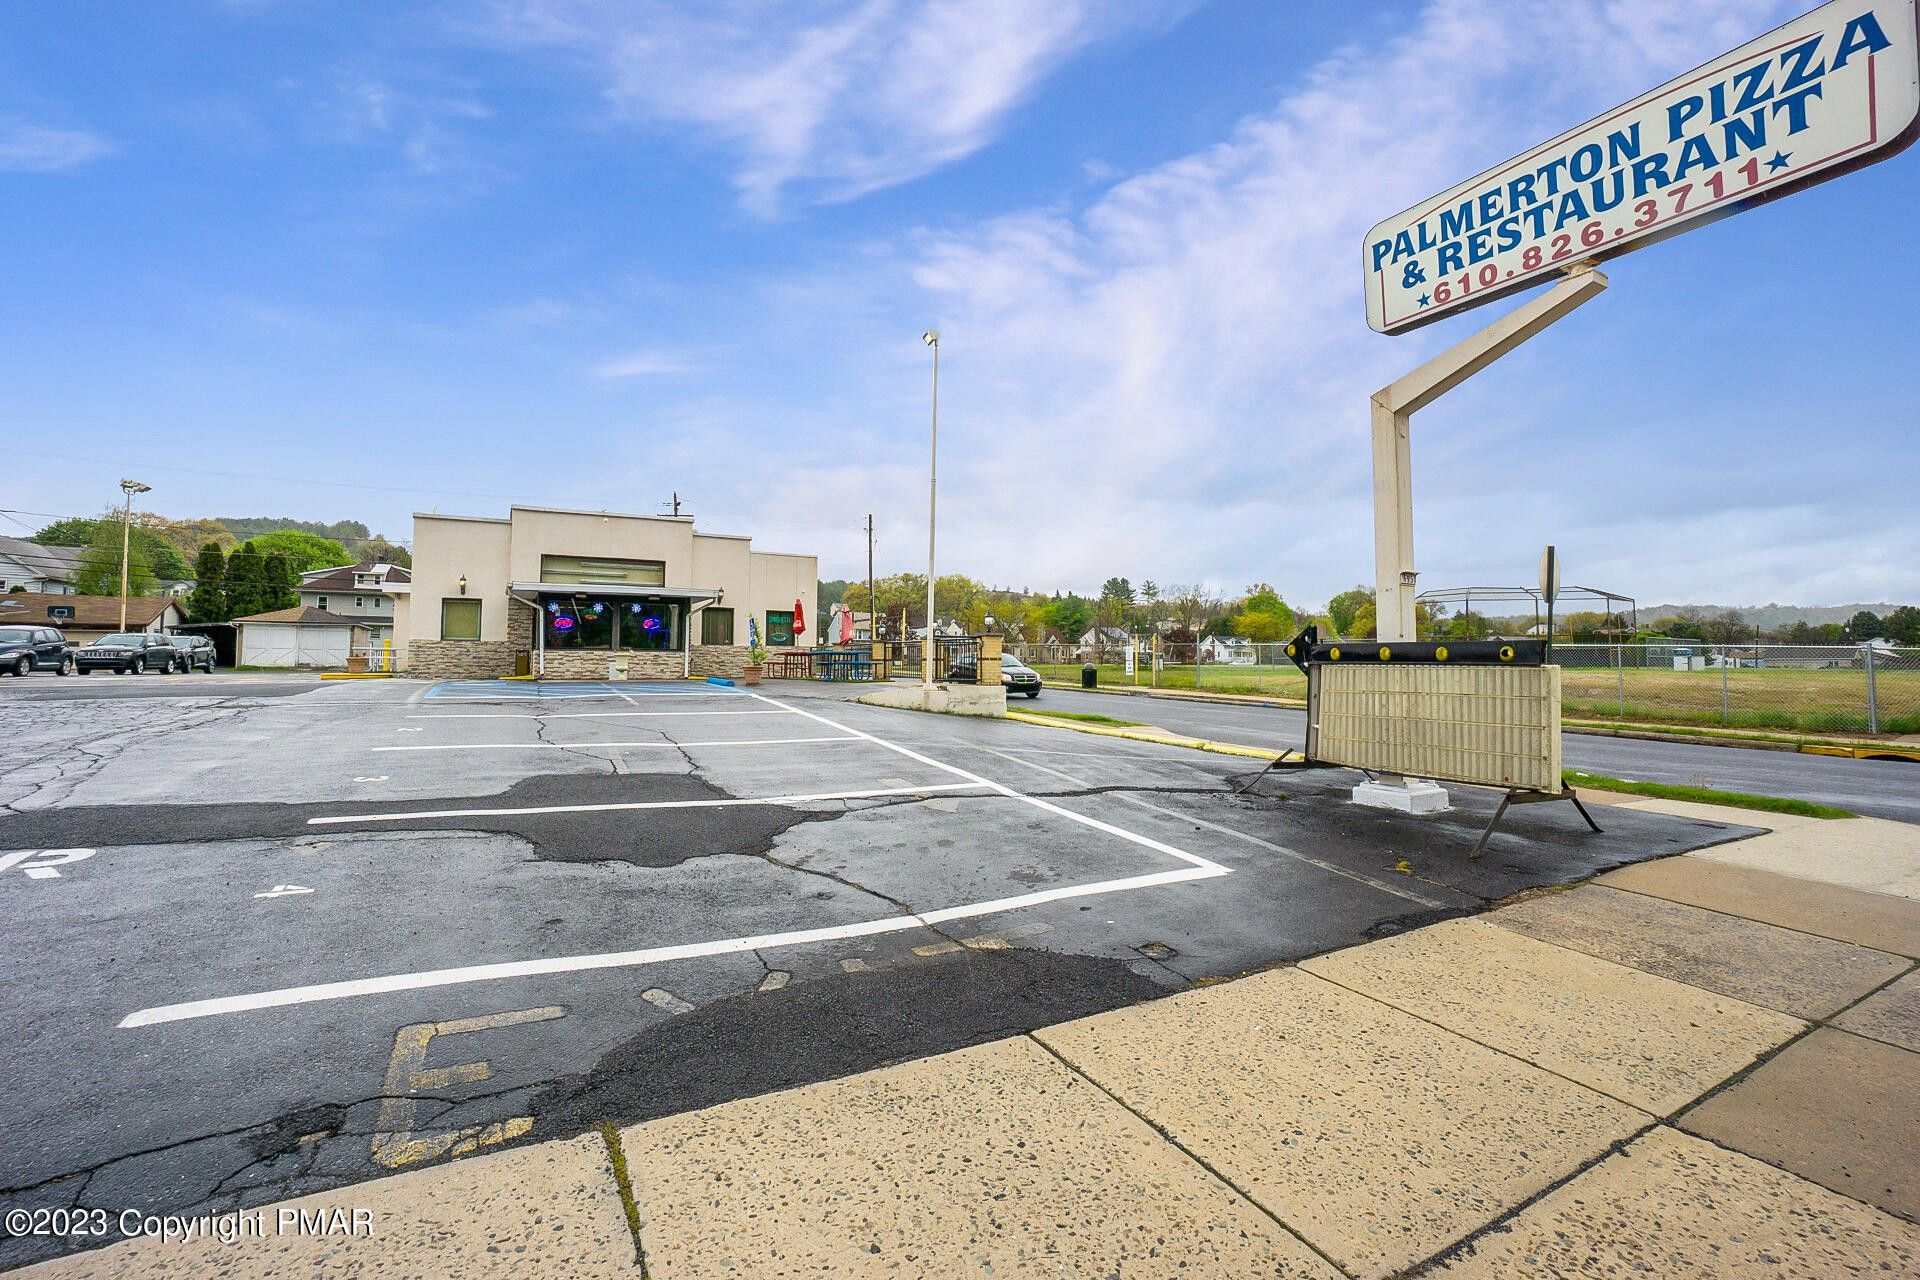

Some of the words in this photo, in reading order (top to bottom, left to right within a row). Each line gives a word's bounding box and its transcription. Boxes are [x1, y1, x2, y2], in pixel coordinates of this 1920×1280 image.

[1371, 120, 1641, 273] PALMERTON
[1665, 10, 1893, 144] PIZZA
[1401, 260, 1427, 289] &
[1437, 81, 1823, 278] RESTAURANT
[1433, 157, 1760, 304] 610.826.3711
